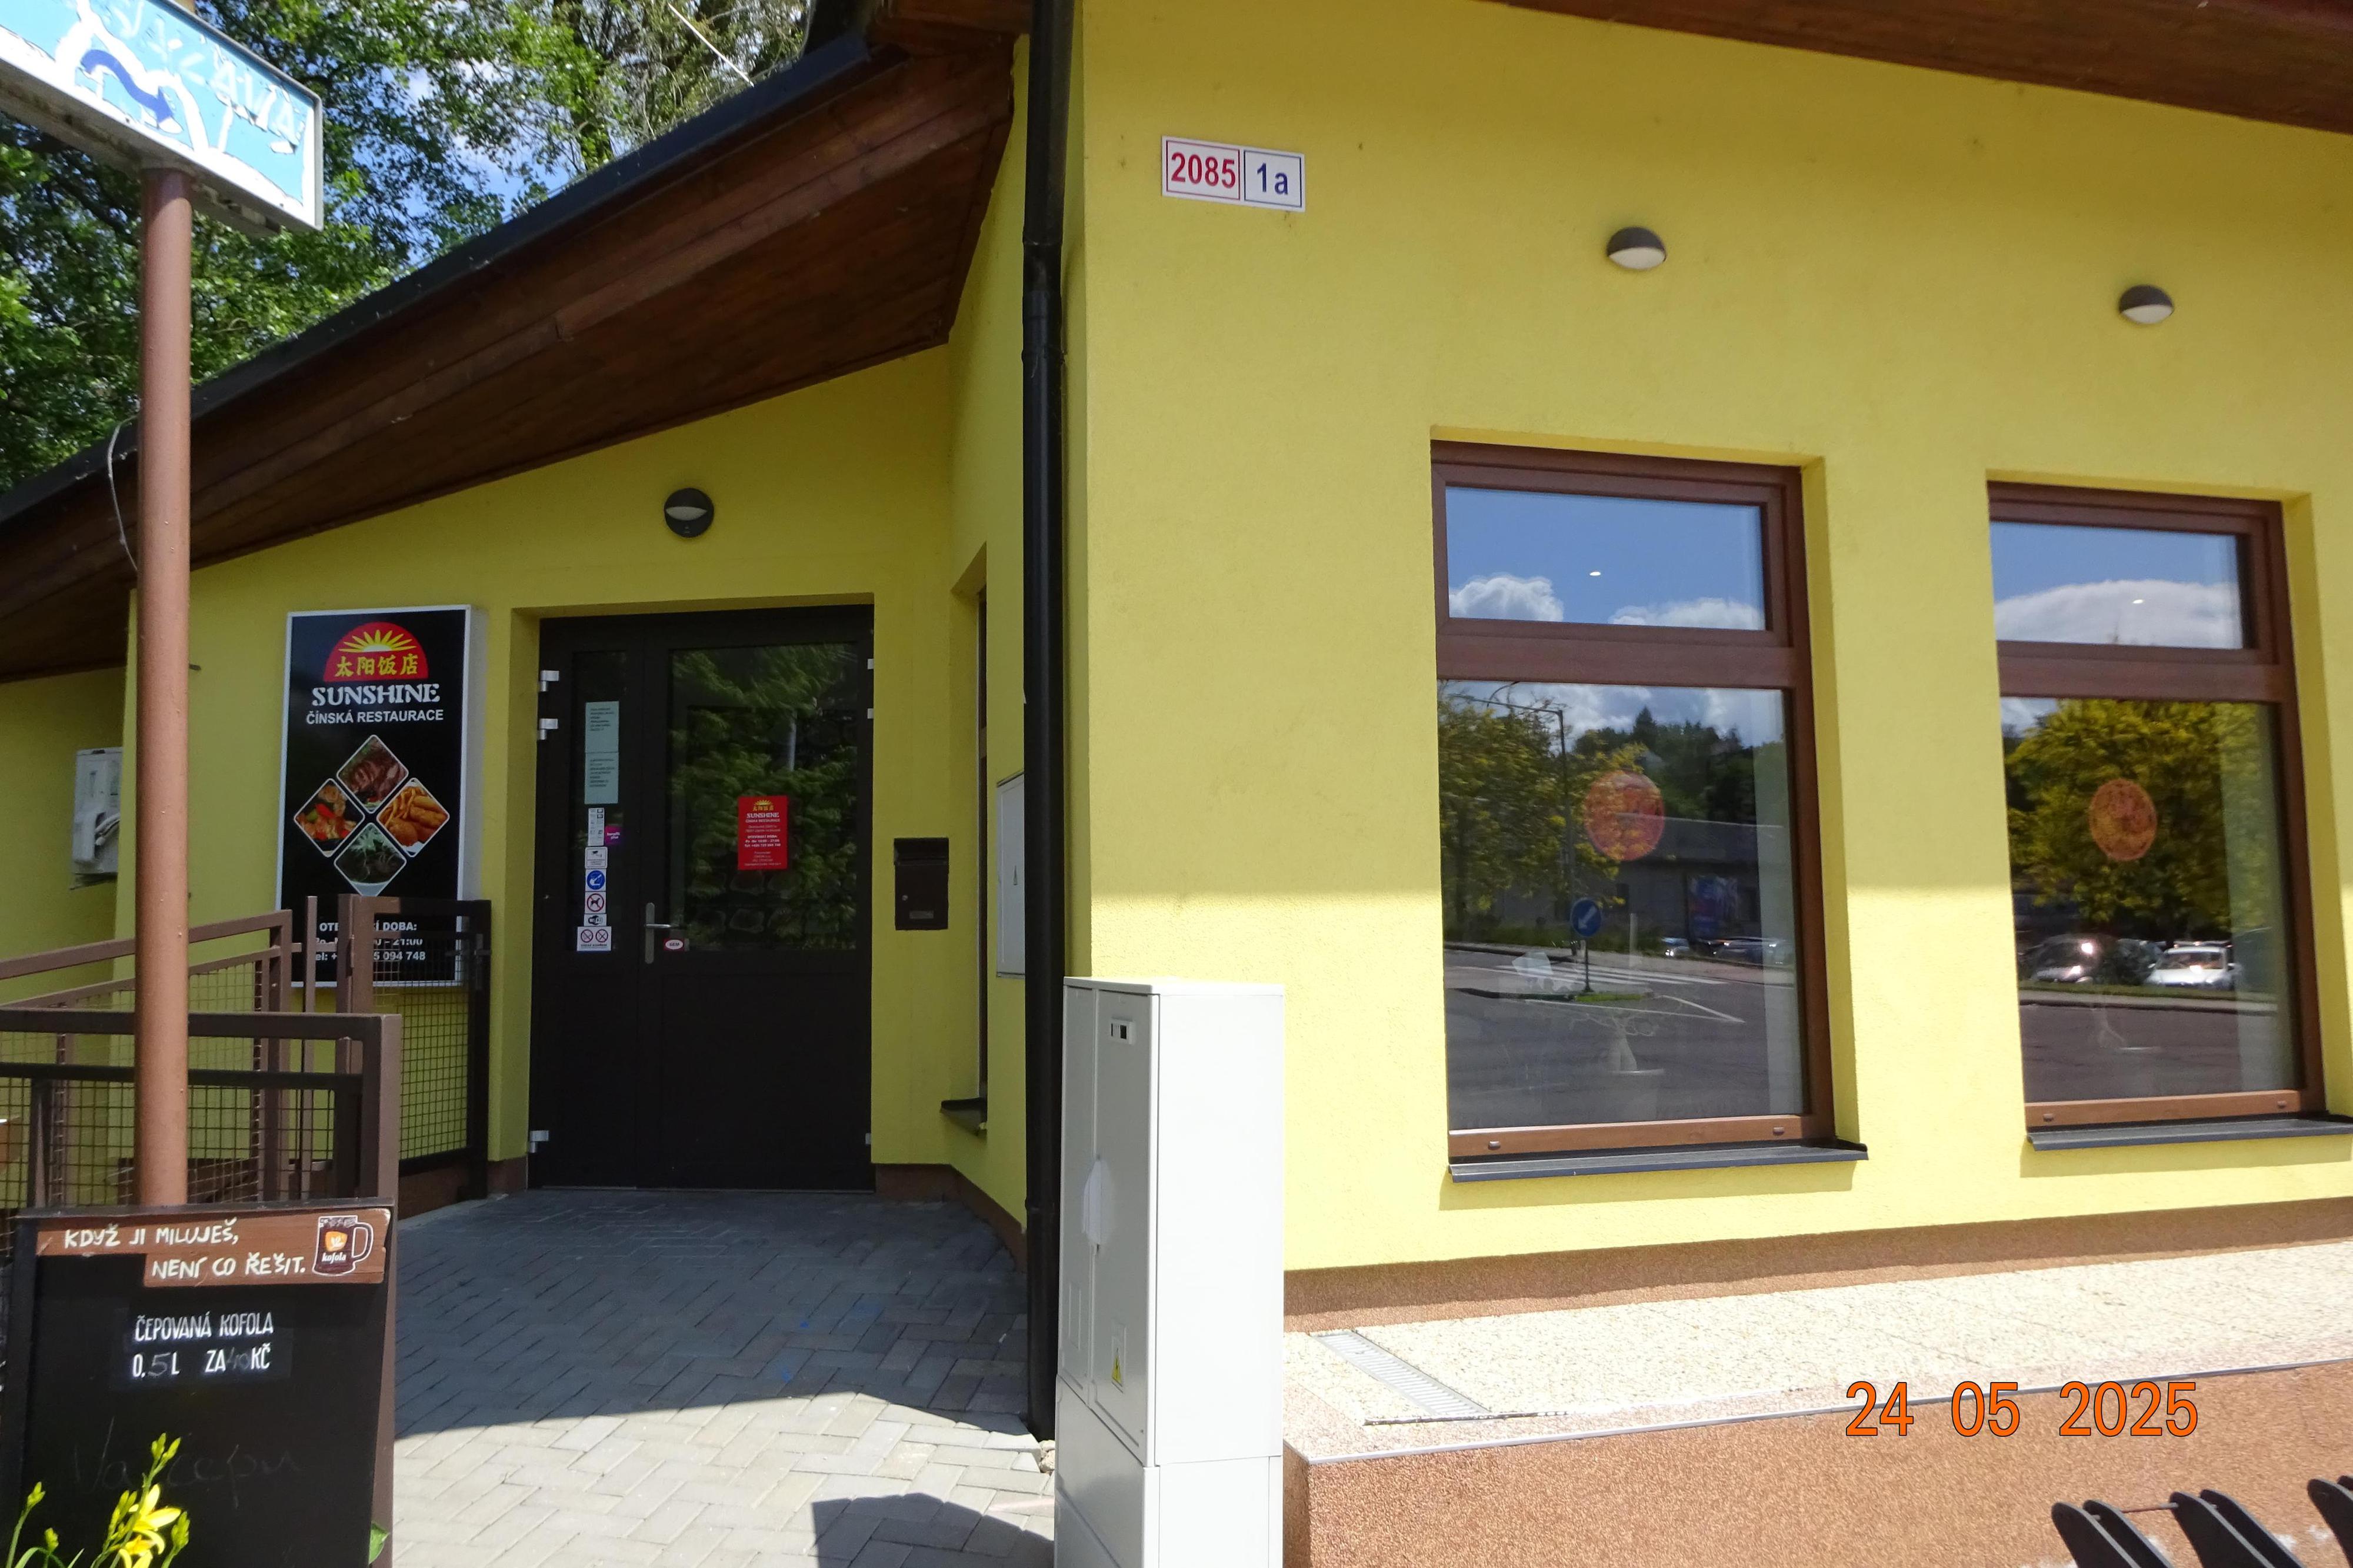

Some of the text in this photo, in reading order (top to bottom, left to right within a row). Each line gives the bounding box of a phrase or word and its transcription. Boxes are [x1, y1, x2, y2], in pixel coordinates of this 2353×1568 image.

[1171, 152, 1236, 188] 2085
[1257, 162, 1288, 195] 1a
[335, 653, 418, 677] 太阳饭店
[312, 683, 440, 706] SUNSHINE
[306, 709, 444, 725] ČÍNSKÁ RESTAURACE
[382, 922, 417, 932] DOBA:
[383, 951, 403, 960] 094
[405, 951, 426, 960] 748
[65, 1217, 239, 1248] KDYŽ JI MILUJEŠ,
[152, 1252, 306, 1279] NENÍ CO ŘEŠIT.
[322, 1253, 346, 1264] kofola
[135, 1311, 274, 1342] ČEPOVANÁ KOFOLA
[205, 1349, 226, 1373] ZA
[251, 1342, 271, 1370] KČ
